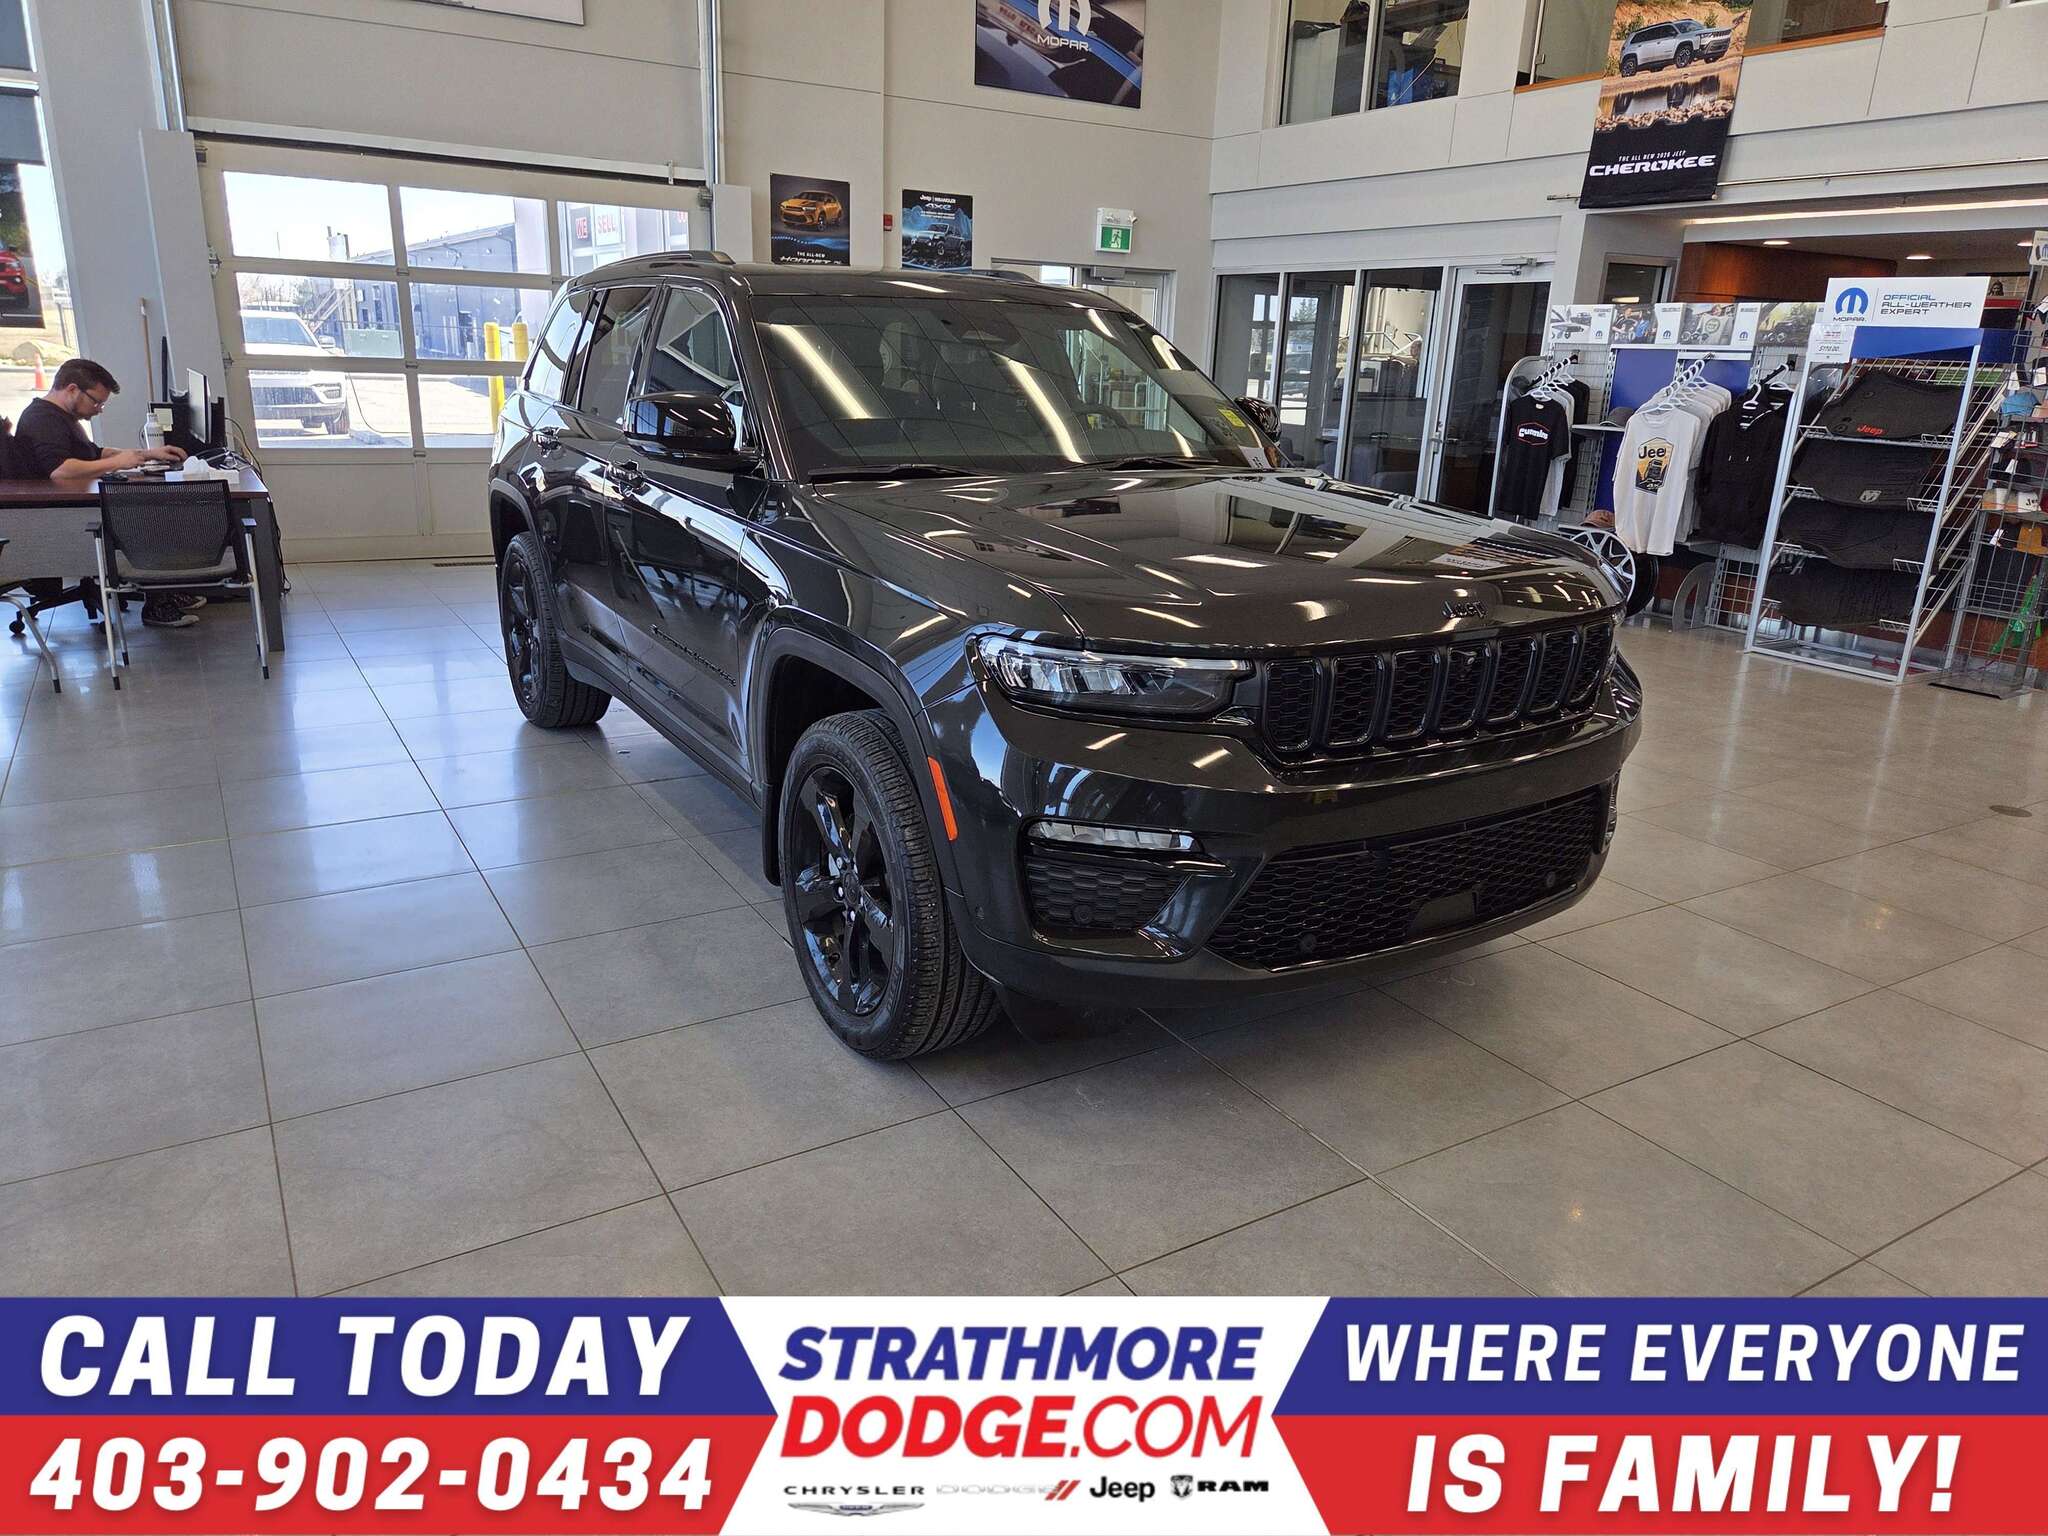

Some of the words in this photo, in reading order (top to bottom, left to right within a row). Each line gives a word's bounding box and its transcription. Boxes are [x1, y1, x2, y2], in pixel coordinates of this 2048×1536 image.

[1037, 34, 1090, 51] MOPAR
[1589, 154, 1716, 176] CHEROKEE
[575, 216, 589, 239] WE
[597, 214, 616, 234] SELL
[1881, 301, 1973, 309] ALL-WEATHER
[1857, 424, 1884, 435] Jeep
[1638, 445, 1666, 459] Jee
